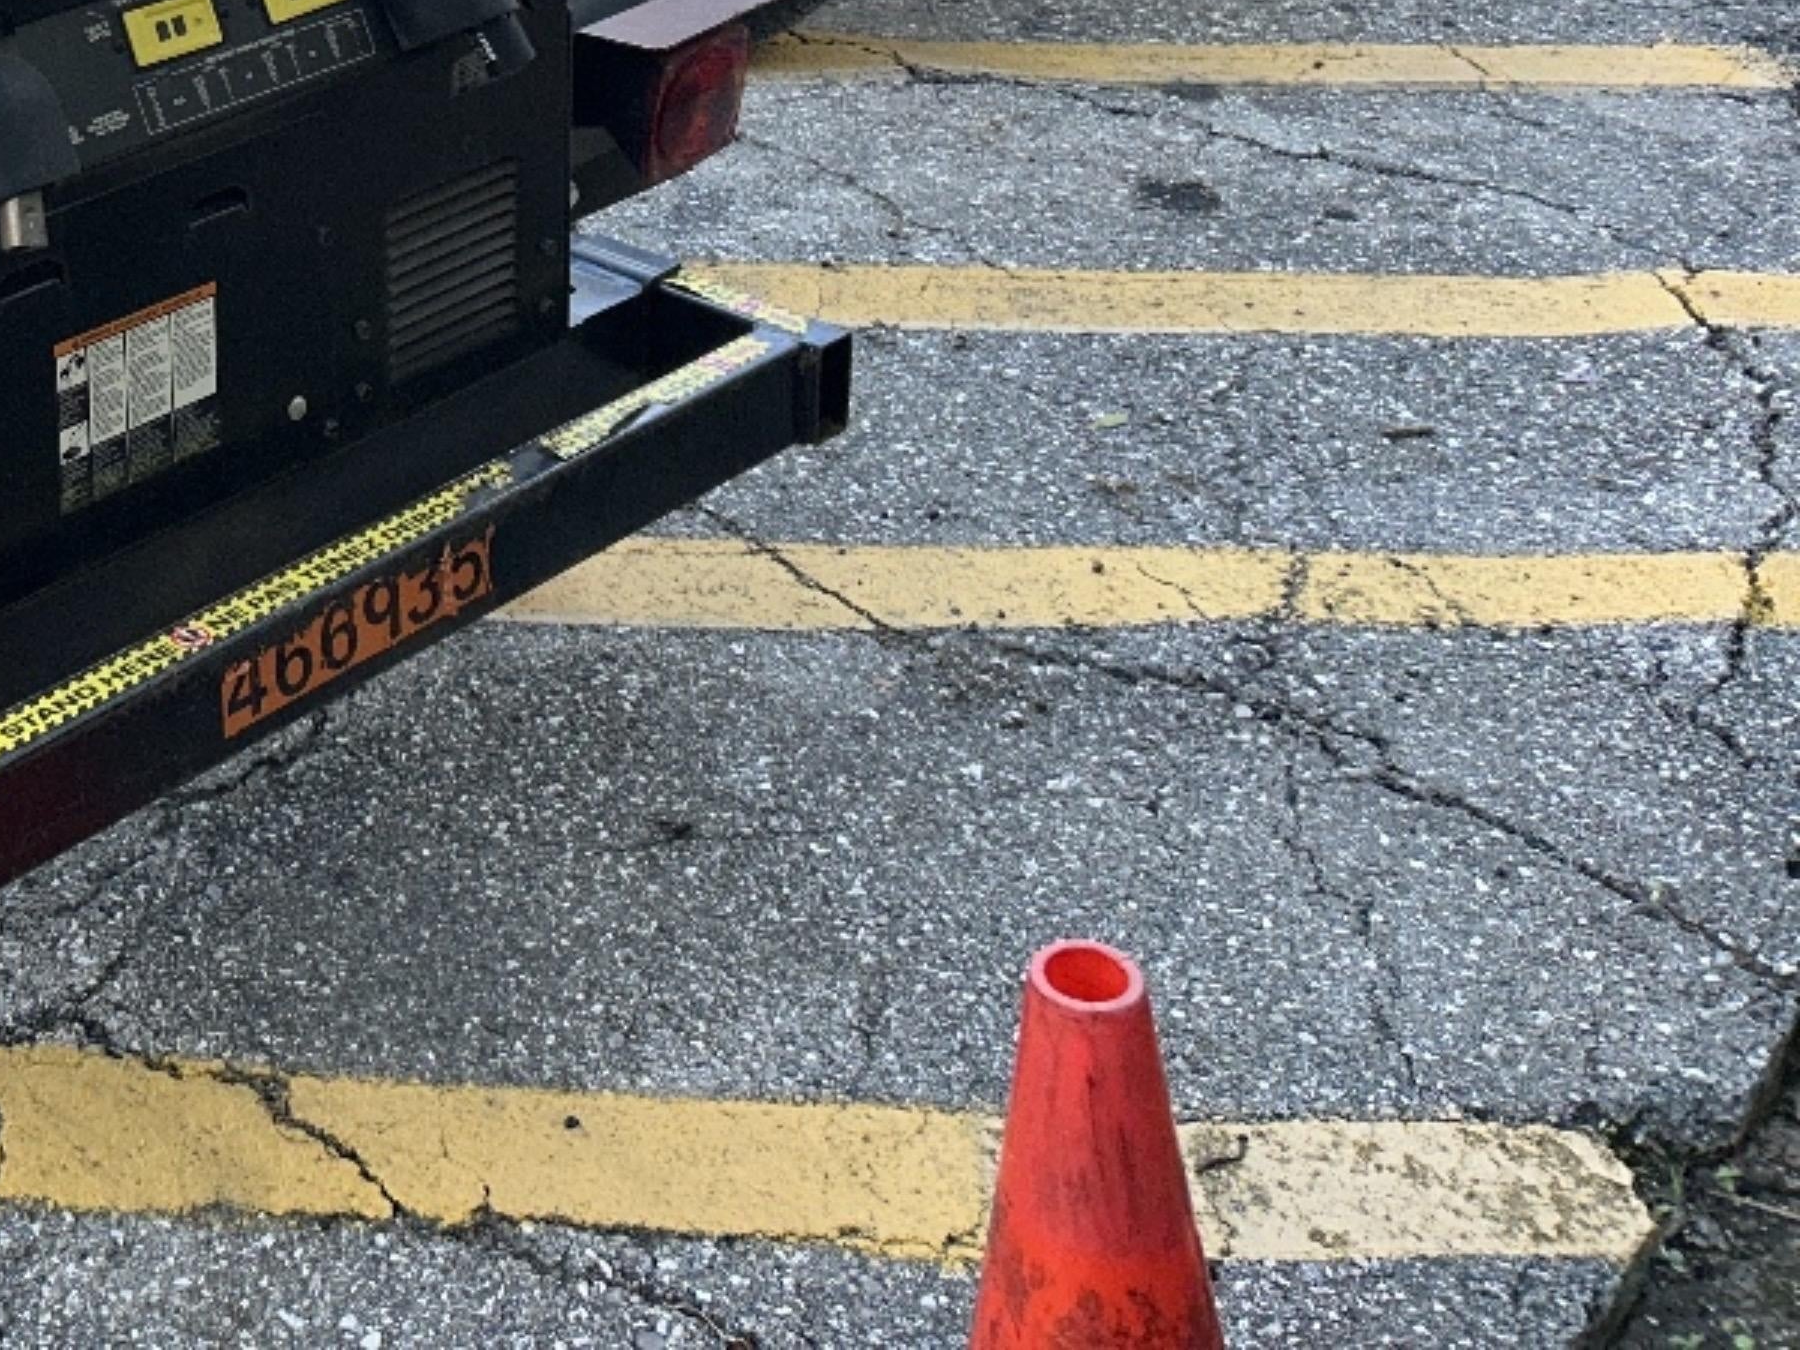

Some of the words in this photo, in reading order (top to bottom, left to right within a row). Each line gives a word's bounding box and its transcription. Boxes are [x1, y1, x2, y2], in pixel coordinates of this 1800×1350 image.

[0, 683, 98, 740] STAND
[99, 645, 179, 690] HERE
[226, 547, 486, 719] 466935
